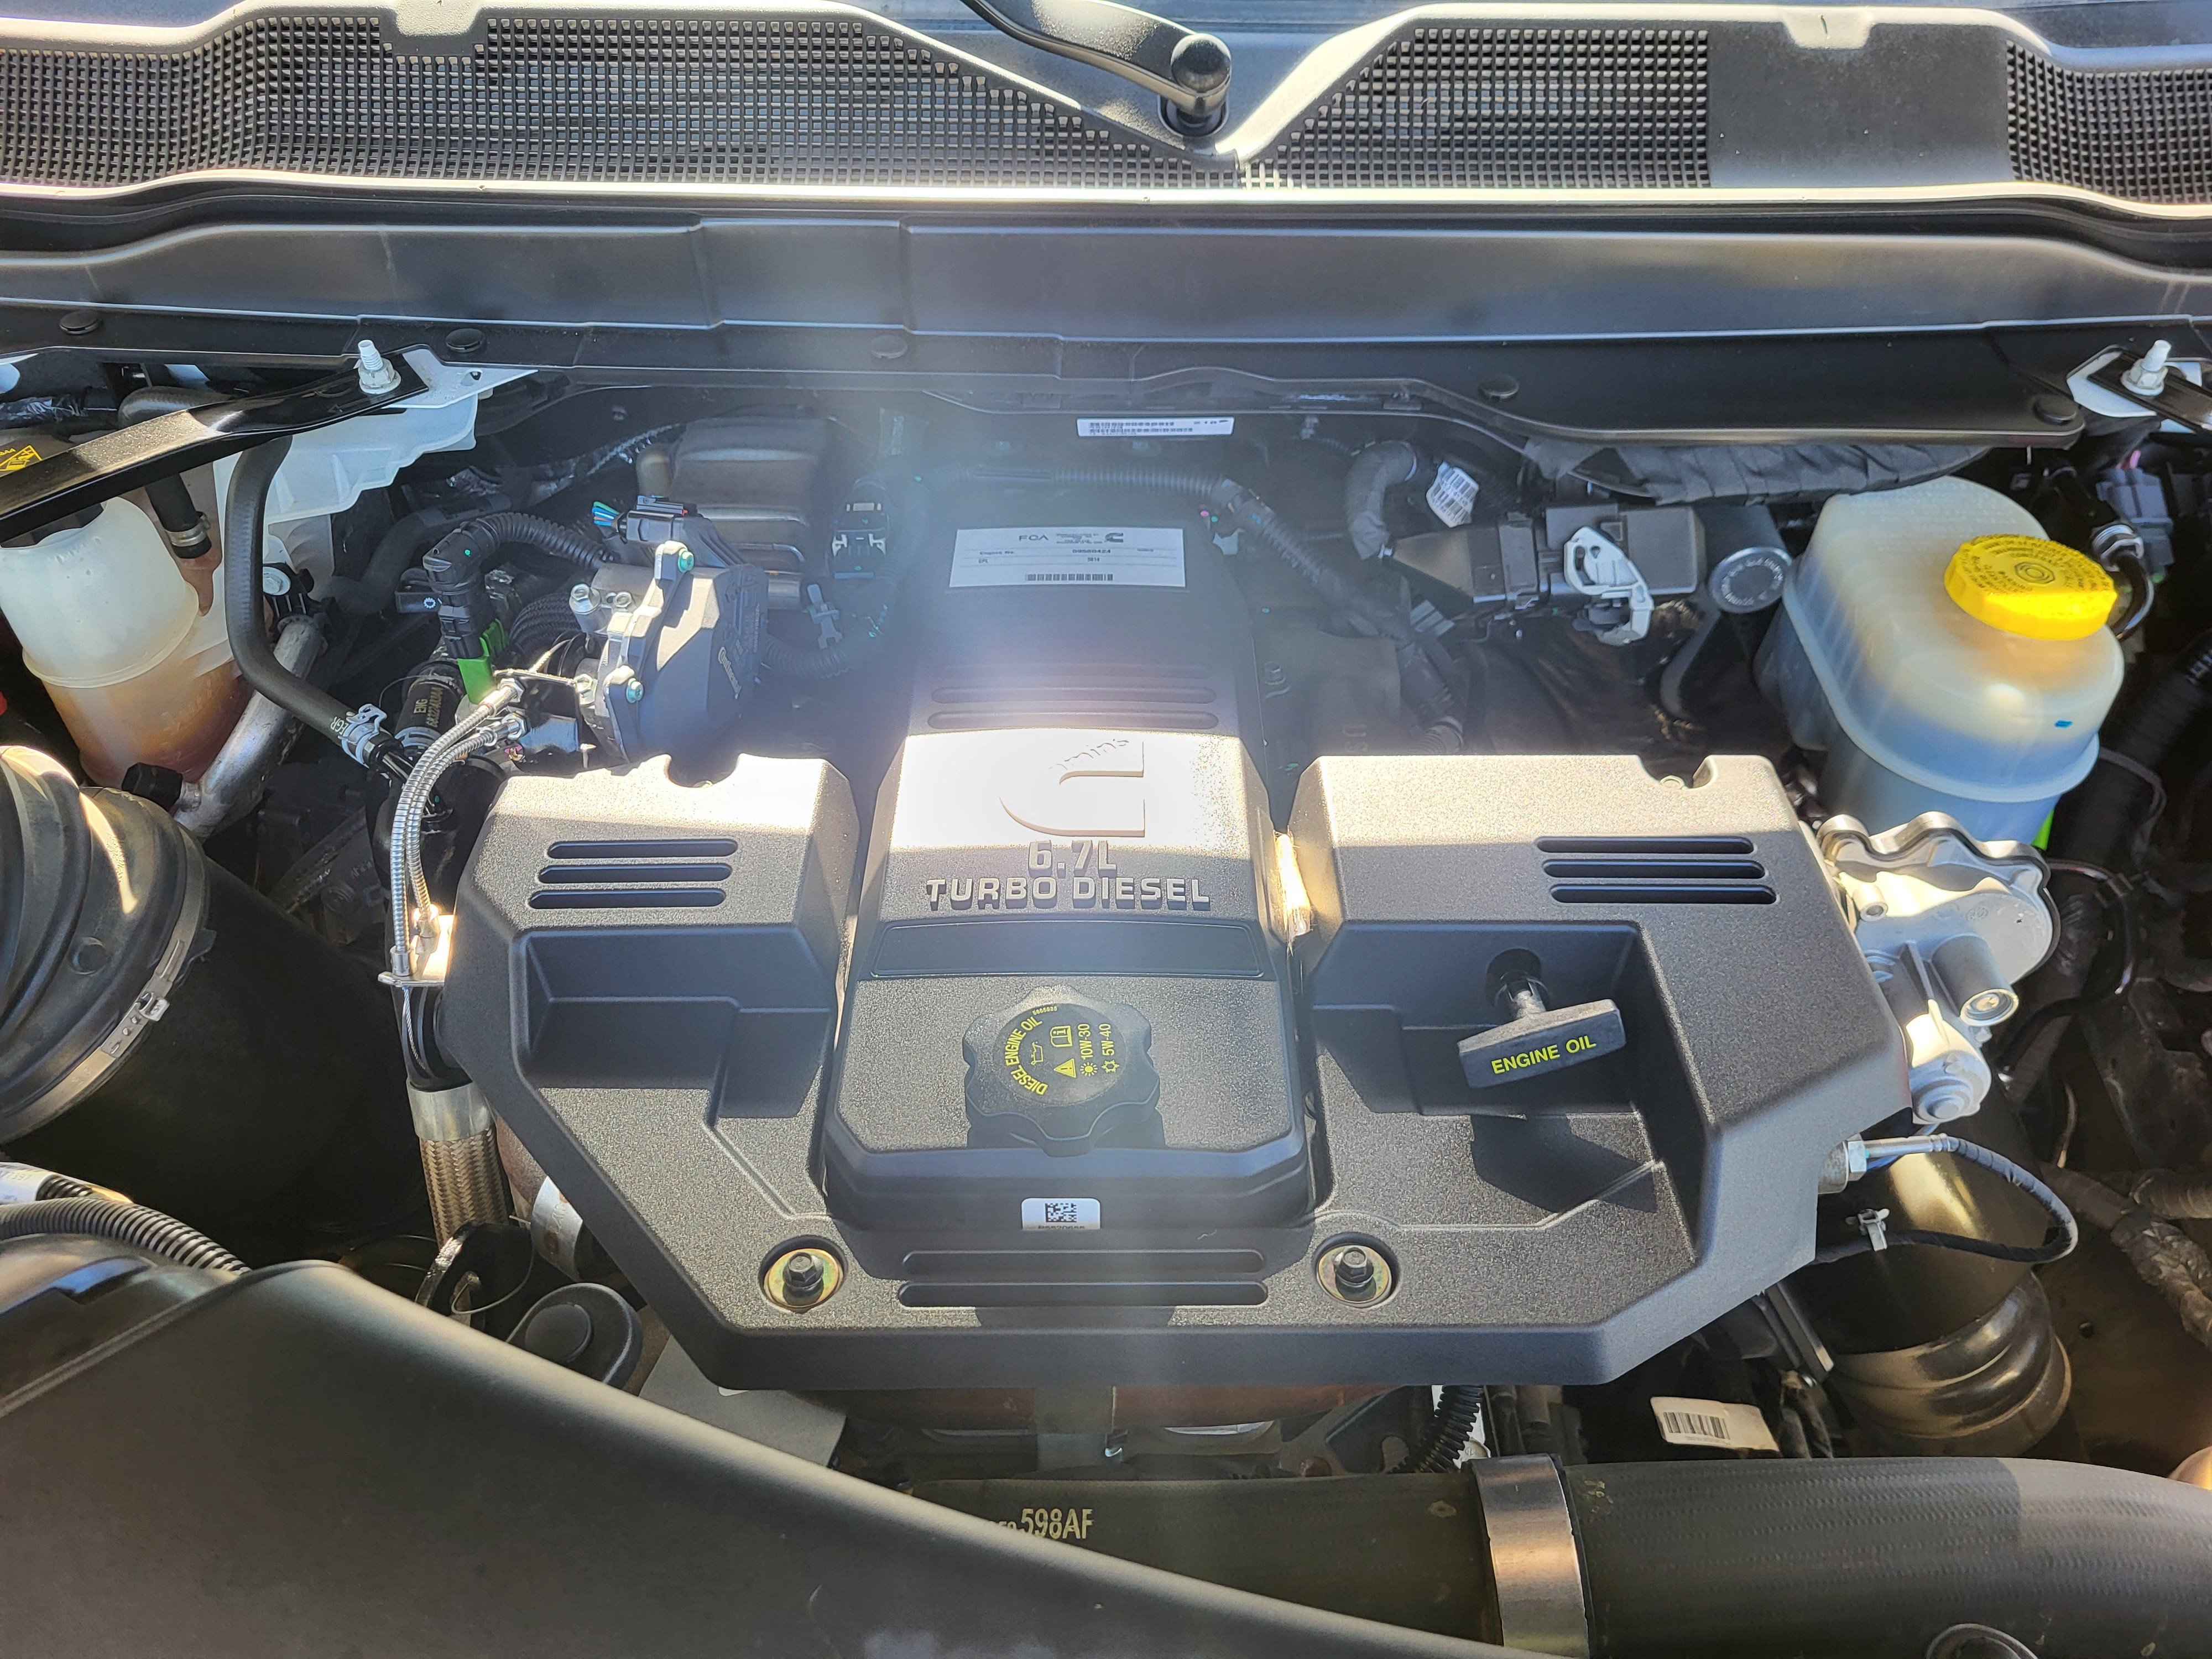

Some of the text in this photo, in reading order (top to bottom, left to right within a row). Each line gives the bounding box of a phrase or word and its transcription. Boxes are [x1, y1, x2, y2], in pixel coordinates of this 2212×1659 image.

[414, 698, 429, 714] ENG
[330, 716, 349, 735] EGR
[1028, 839, 1118, 877] 6.7L
[926, 877, 1211, 911] TURBO DIESEL
[1004, 1016, 1048, 1095] DIESEL ENGINE OIL
[1077, 1023, 1094, 1060] 10W-30
[1098, 1023, 1115, 1056] 5W-40
[1491, 1035, 1597, 1074] ENGINE OIL
